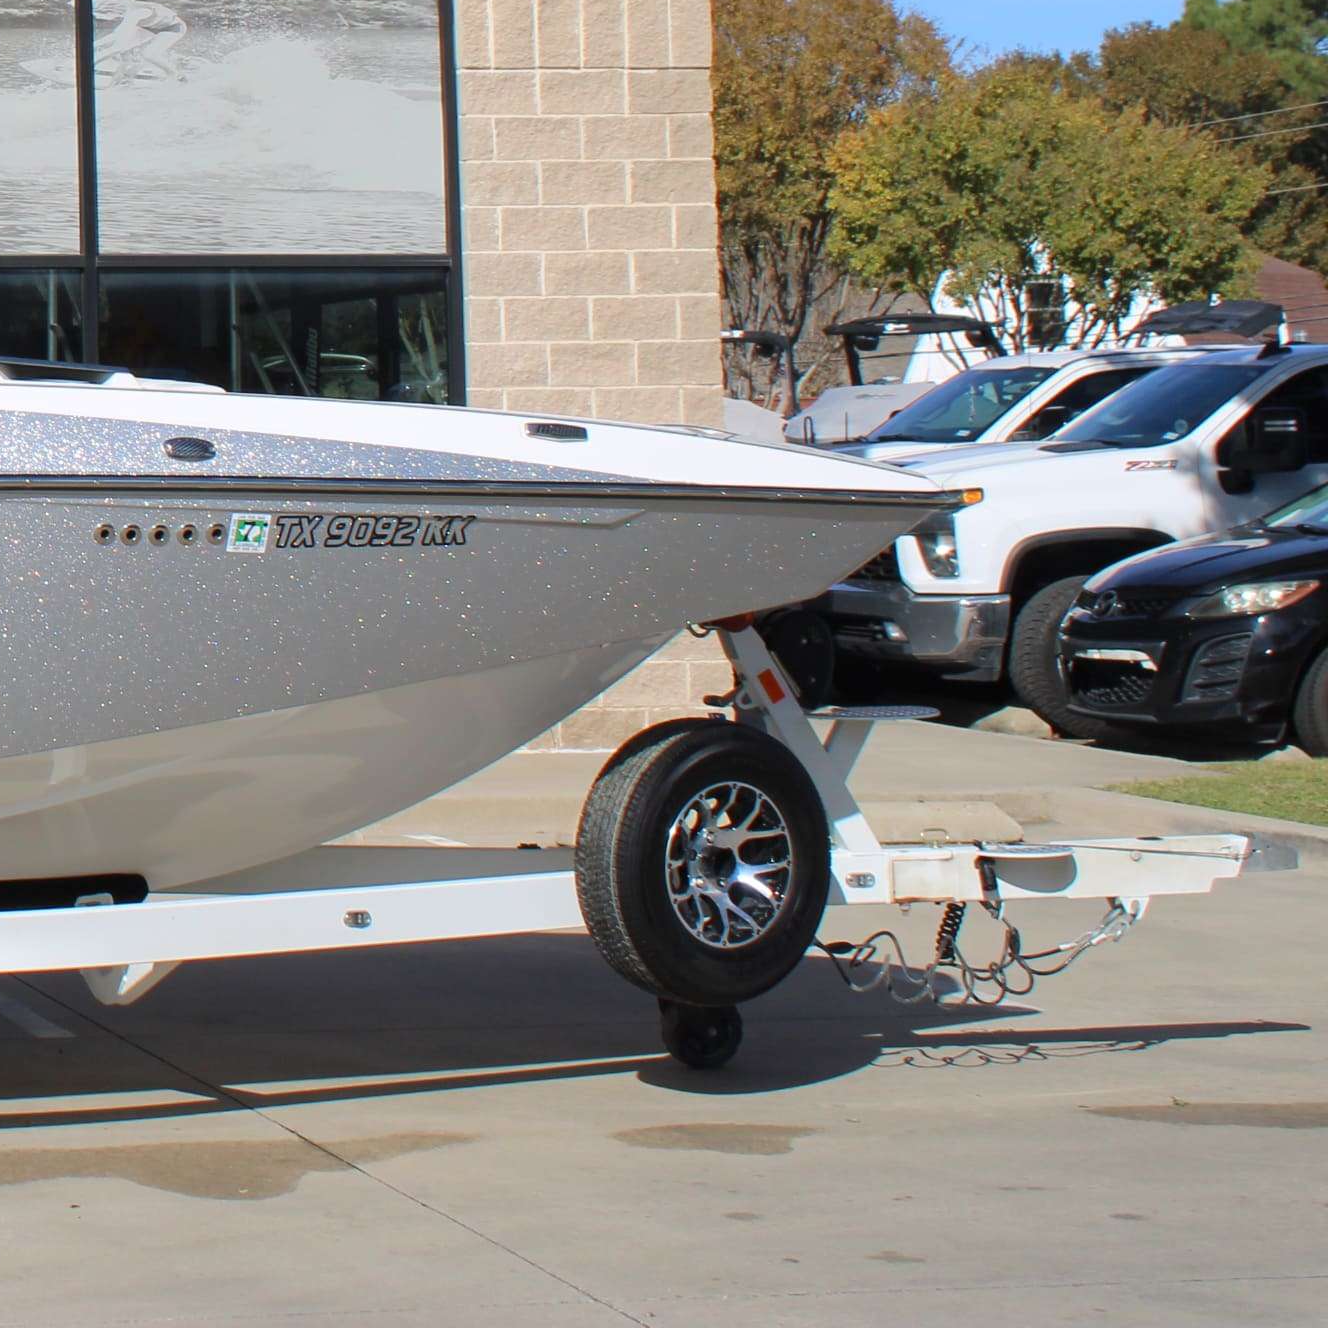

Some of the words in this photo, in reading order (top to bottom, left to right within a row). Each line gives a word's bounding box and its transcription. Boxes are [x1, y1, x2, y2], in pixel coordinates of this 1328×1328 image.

[276, 515, 323, 548] TX
[324, 515, 421, 548] 9092
[421, 515, 476, 547] KK
